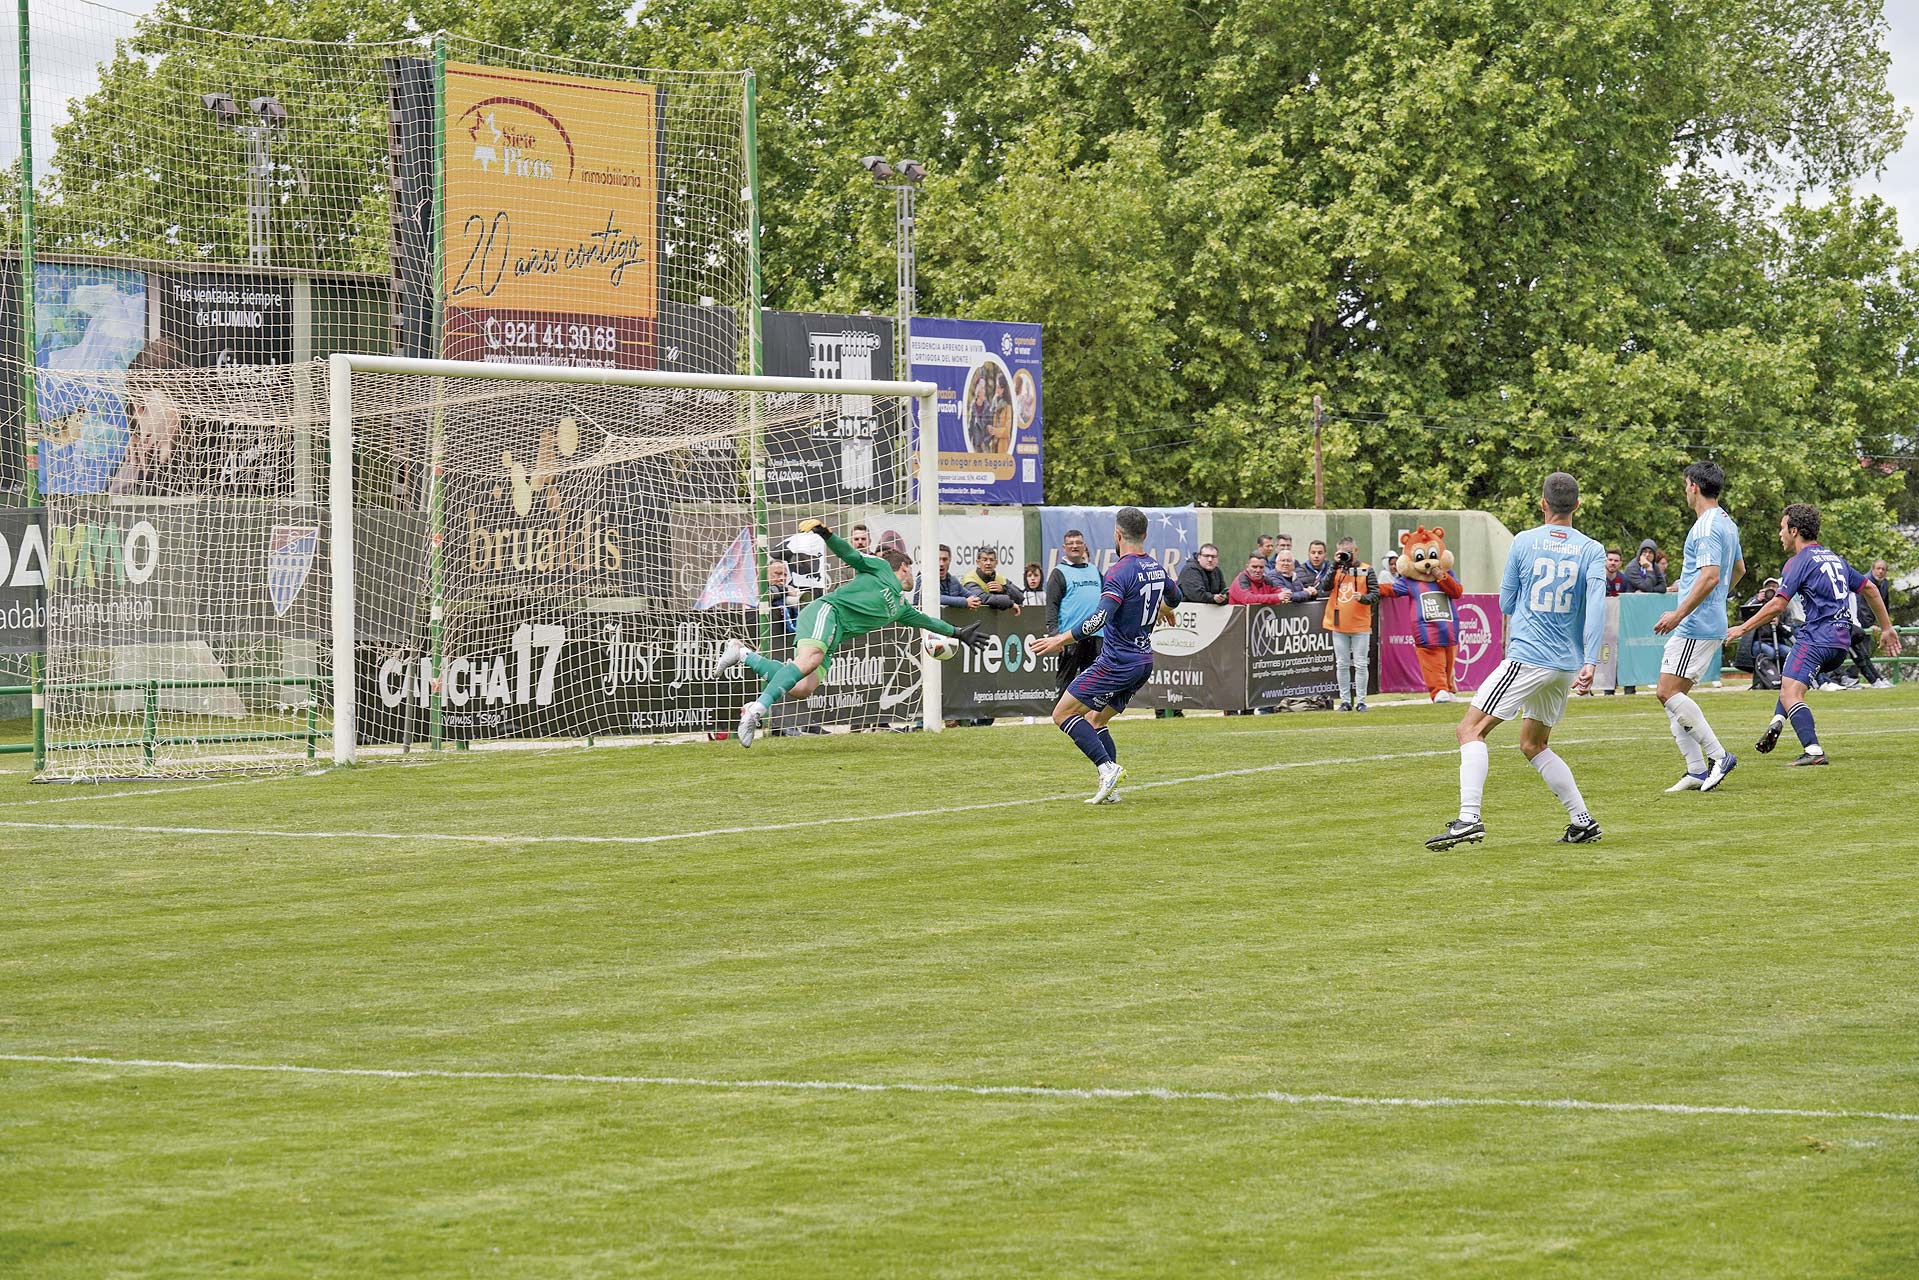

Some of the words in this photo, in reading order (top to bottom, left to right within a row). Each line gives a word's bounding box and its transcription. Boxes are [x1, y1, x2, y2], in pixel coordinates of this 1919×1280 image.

[503, 127, 536, 149] Siete
[503, 146, 554, 179] Picos
[581, 166, 641, 188] inmobiliaria
[452, 211, 510, 297] 20
[563, 209, 646, 288] contigo
[174, 285, 191, 302] Tus
[194, 287, 239, 304] ventanas
[241, 288, 282, 309] siempre
[196, 308, 209, 326] de
[211, 311, 262, 328] ALUMINIO
[505, 321, 538, 348] 921
[542, 326, 563, 349] 41
[568, 326, 590, 350] 30
[593, 327, 616, 351] 68
[911, 341, 941, 350] RESIDENCIA
[942, 344, 965, 352] APRENDE
[985, 458, 1014, 470] Segovia
[468, 506, 622, 572] brualdis
[1530, 557, 1579, 614] 22
[1820, 561, 1849, 600] 15
[61, 597, 153, 625] Ammunition
[1139, 581, 1165, 628] 17
[1265, 616, 1310, 638] MUNDO
[1275, 633, 1334, 655] LABORAL
[379, 655, 512, 708] CANCHA
[512, 623, 566, 706] 17
[603, 623, 661, 696] José
[820, 643, 886, 686] antador
[1252, 659, 1281, 670] uniformes
[1285, 655, 1314, 668] protección
[1315, 653, 1334, 663] laboral
[806, 692, 827, 709] vinos
[828, 694, 836, 712] y
[836, 689, 865, 708] viandas
[973, 691, 994, 704] Agencia
[994, 689, 1008, 701] oficial
[632, 708, 713, 729] RESTAURANTE
